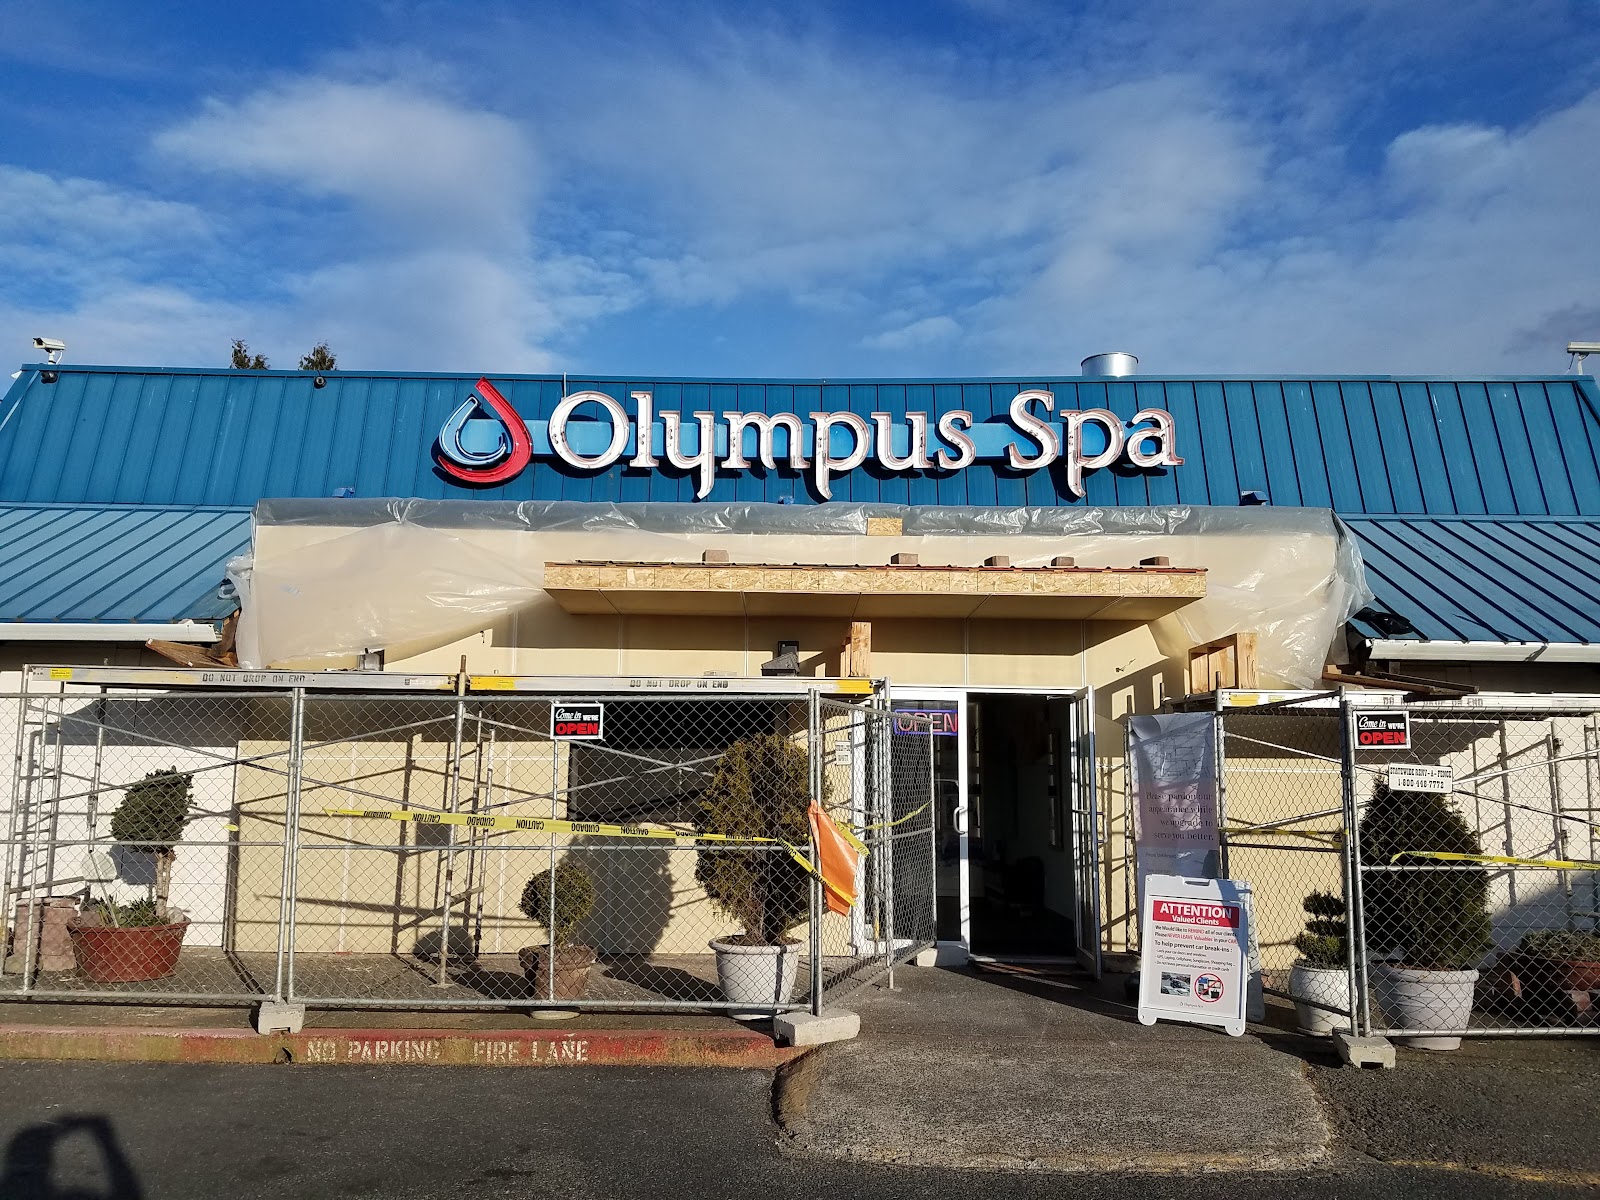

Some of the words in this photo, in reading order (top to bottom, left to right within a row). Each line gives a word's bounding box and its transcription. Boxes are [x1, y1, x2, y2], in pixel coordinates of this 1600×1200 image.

[549, 390, 976, 500] Olympus
[1010, 389, 1185, 498] Spa
[202, 673, 214, 682] DO
[243, 674, 267, 683] DROP
[288, 674, 306, 683] END
[629, 679, 641, 688] DO
[668, 679, 692, 688] DROP
[696, 680, 708, 689] ON
[712, 680, 729, 689] END
[555, 708, 574, 719] Come
[574, 711, 582, 719] in
[897, 712, 958, 733] OPEN
[1358, 716, 1378, 728] Come
[1378, 719, 1387, 728] in
[555, 722, 599, 735] OPEN
[1360, 731, 1406, 744] OPEN
[1390, 767, 1414, 776] STATEWIDE
[1168, 791, 1197, 802] pardon
[1148, 806, 1189, 815] appearance
[1190, 804, 1213, 814] while
[412, 813, 441, 824] CAUTION
[466, 816, 496, 827] CUIDADO
[515, 818, 545, 830] CAUTION
[1170, 818, 1203, 829] upgrade
[1205, 819, 1214, 827] to
[571, 822, 600, 833] CUIDADO
[620, 826, 649, 836] CAUTION
[1171, 833, 1185, 842] you
[1160, 902, 1232, 919] ATTENTION
[1172, 914, 1196, 924] Valued
[1196, 917, 1219, 926] Clients
[1174, 943, 1195, 951] prevent
[307, 1040, 336, 1062] NO
[348, 1039, 443, 1062] PARKING
[473, 1040, 520, 1063] FIRE
[531, 1039, 589, 1063] LANE
